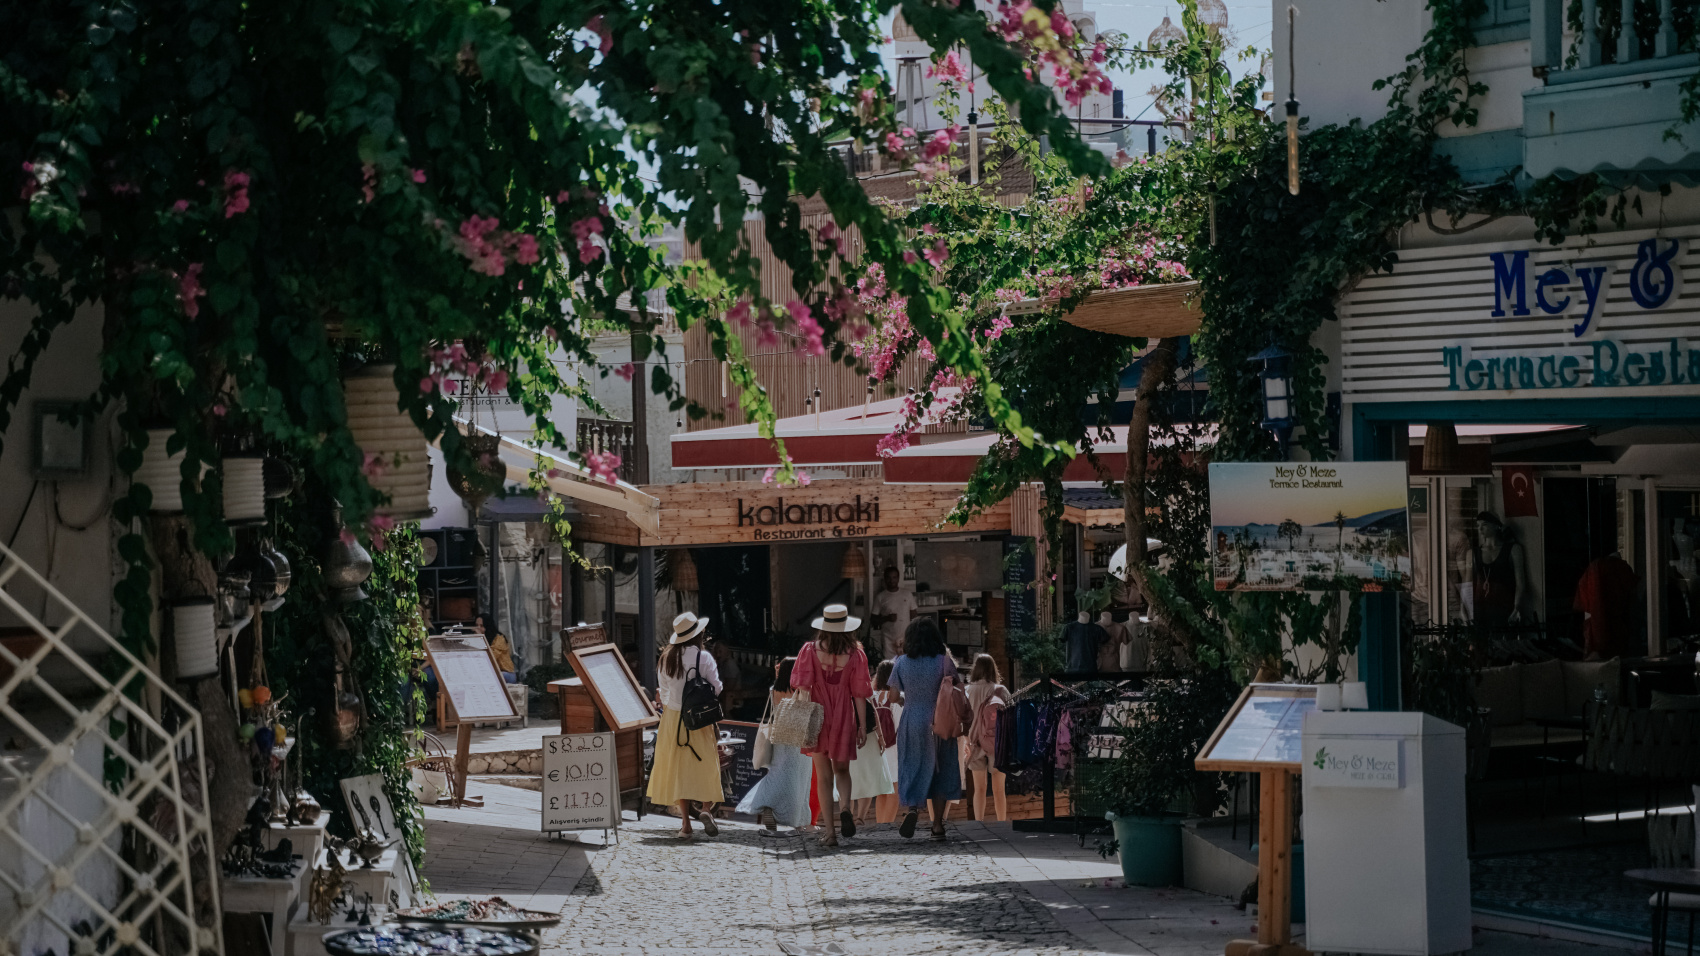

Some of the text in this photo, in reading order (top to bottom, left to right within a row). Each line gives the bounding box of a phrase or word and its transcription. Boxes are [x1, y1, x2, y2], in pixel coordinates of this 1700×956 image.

[1490, 237, 1680, 338] Mey &
[1443, 345, 1580, 391] Terrace
[1275, 464, 1337, 482] Mey & Meze
[1269, 479, 1344, 489] Terrace Restaurant
[737, 494, 880, 528] kalamaki
[754, 524, 871, 541] Restaurant & Bar
[549, 740, 558, 755] $
[1327, 754, 1396, 775] Mey & Meze
[547, 769, 560, 782] €
[549, 796, 559, 810] £
